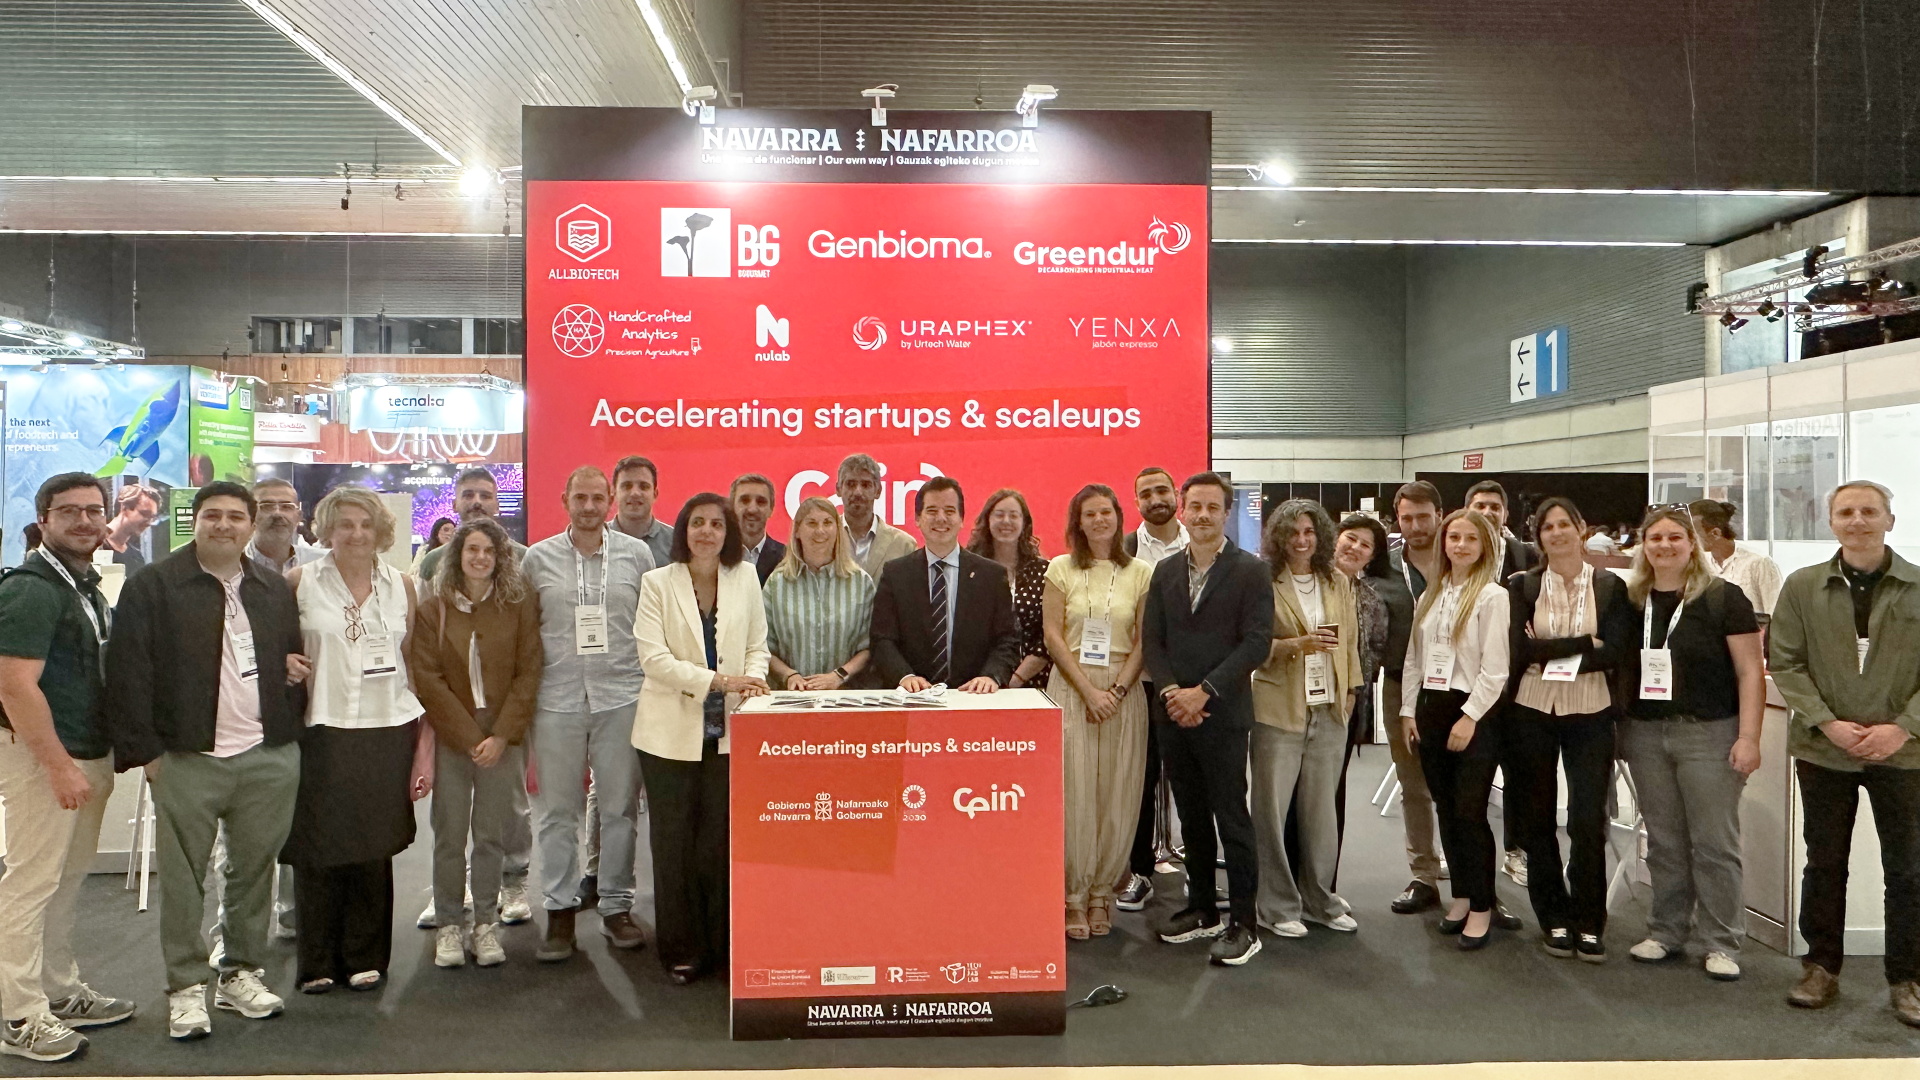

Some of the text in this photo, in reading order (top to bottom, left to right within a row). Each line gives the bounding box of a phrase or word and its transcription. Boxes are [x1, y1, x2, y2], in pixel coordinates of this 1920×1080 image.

[702, 127, 1039, 152] NAVARRA NAFARROA
[769, 154, 817, 165] funcionar
[825, 155, 844, 165] Our
[846, 157, 866, 165] own
[868, 157, 887, 167] way
[934, 155, 970, 167] egiteko
[972, 155, 1003, 167] dugun
[1013, 241, 1160, 266] Greendur
[548, 268, 620, 280] ALLBIOTECH
[1095, 266, 1135, 274] INDUSTRIAL
[608, 309, 692, 323] HandCrafted
[621, 328, 679, 345] Analytics
[901, 339, 972, 350] by Urtech Water
[645, 348, 690, 360] Agriculture
[755, 350, 791, 362] nulab
[1545, 329, 1558, 393] 1
[9, 417, 51, 427] the next
[590, 399, 1141, 437] Accelerating startups & scaleups
[60, 429, 79, 439] and
[758, 737, 1037, 759] Accelerating startups & scaleups
[767, 801, 811, 810] Gobierno
[836, 799, 889, 808] Nafarroako
[759, 812, 811, 821] de Navarra
[836, 811, 883, 820] Gobernua
[902, 814, 927, 822] 2030
[808, 1002, 992, 1019] NAVARRA NAFARROA
